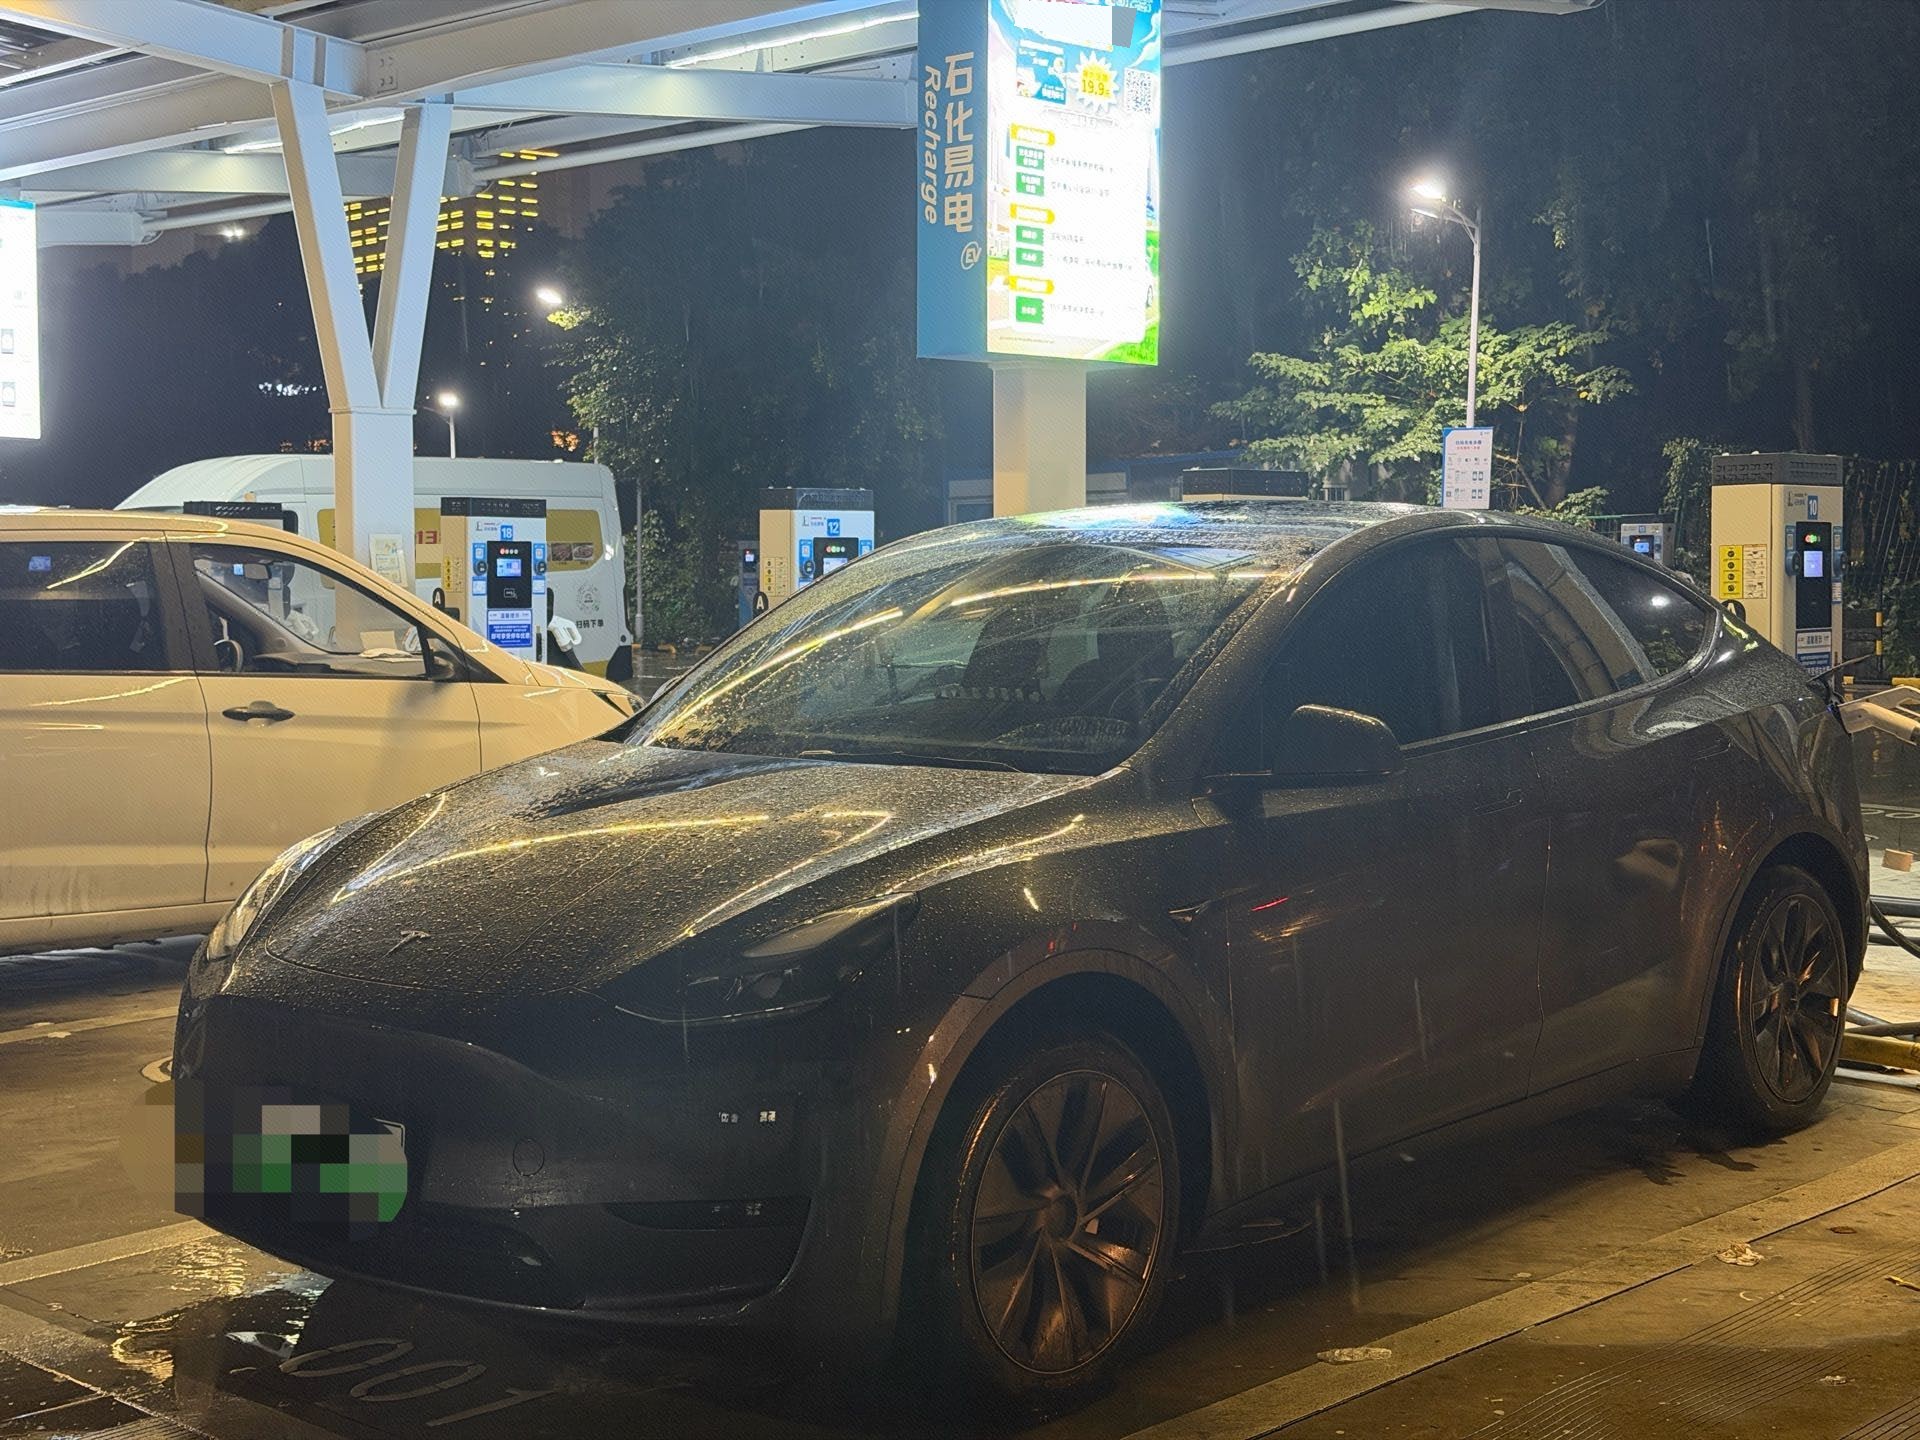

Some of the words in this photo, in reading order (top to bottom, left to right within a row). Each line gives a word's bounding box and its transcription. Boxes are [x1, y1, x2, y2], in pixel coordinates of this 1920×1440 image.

[921, 65, 941, 224] Recharge
[944, 51, 974, 233] 石化易电
[1808, 499, 1818, 516] 10
[501, 527, 513, 539] 18
[828, 521, 840, 534] 12
[756, 595, 765, 610] A
